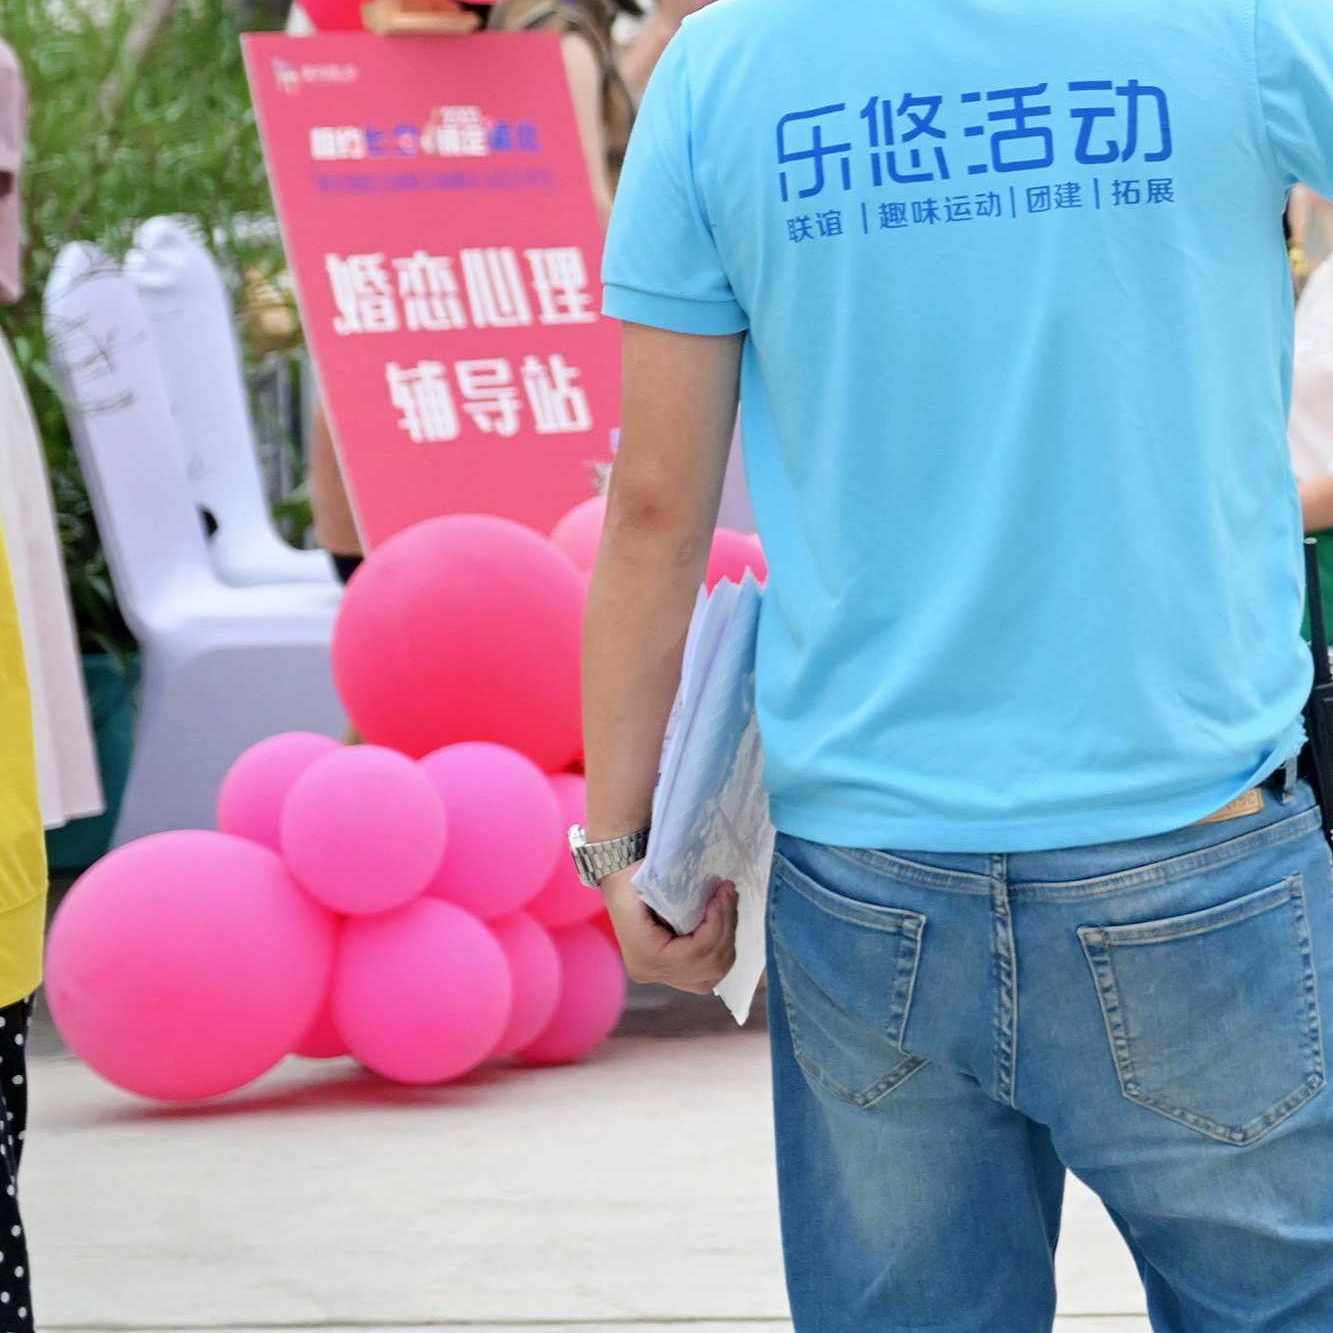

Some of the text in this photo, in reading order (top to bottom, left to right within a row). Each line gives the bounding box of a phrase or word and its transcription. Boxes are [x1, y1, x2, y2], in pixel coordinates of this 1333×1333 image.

[775, 78, 1173, 204] 乐悠活动
[788, 176, 1177, 244] 联谊 趣味运动 团建 拓展
[325, 247, 599, 335] 婚恋心理
[384, 354, 593, 443] 辅导站
